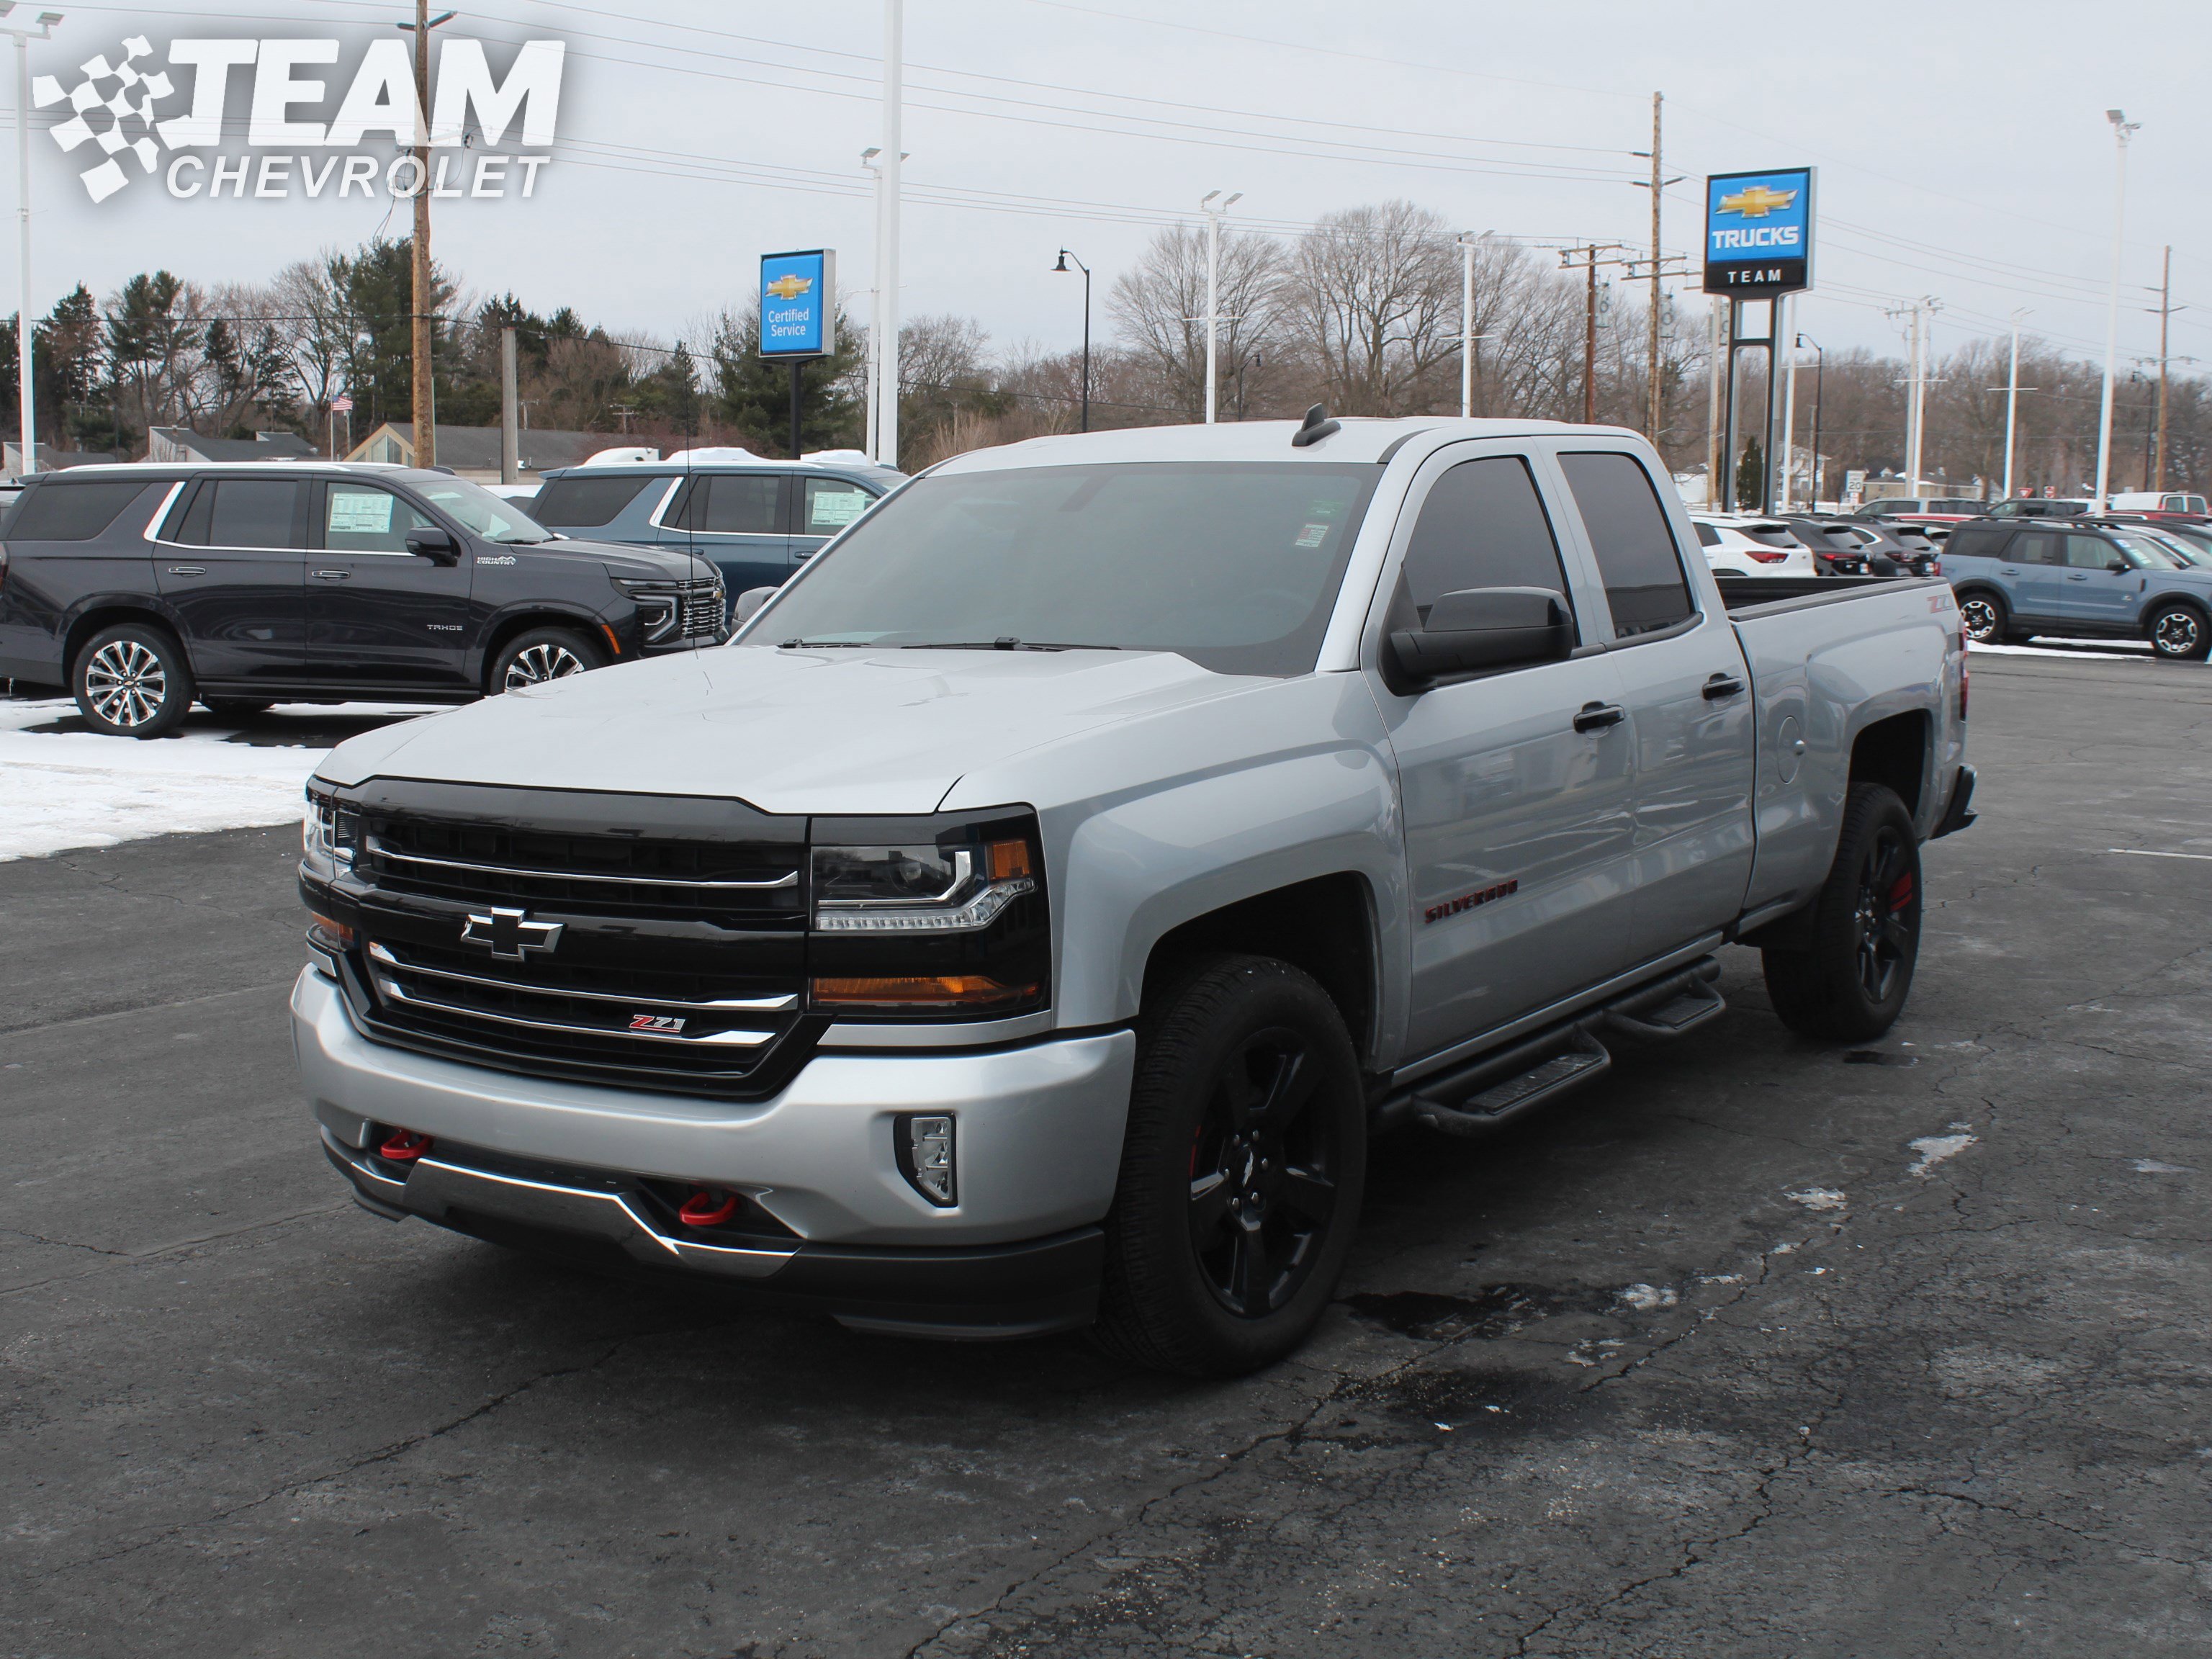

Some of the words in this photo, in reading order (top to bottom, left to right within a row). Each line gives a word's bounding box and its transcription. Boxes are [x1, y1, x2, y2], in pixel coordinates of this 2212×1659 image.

[1712, 225, 1799, 248] TRUCKS
[1727, 269, 1781, 283] TEAM
[768, 308, 809, 323] Certified
[771, 324, 806, 337] Service
[629, 1014, 685, 1033] Z71
